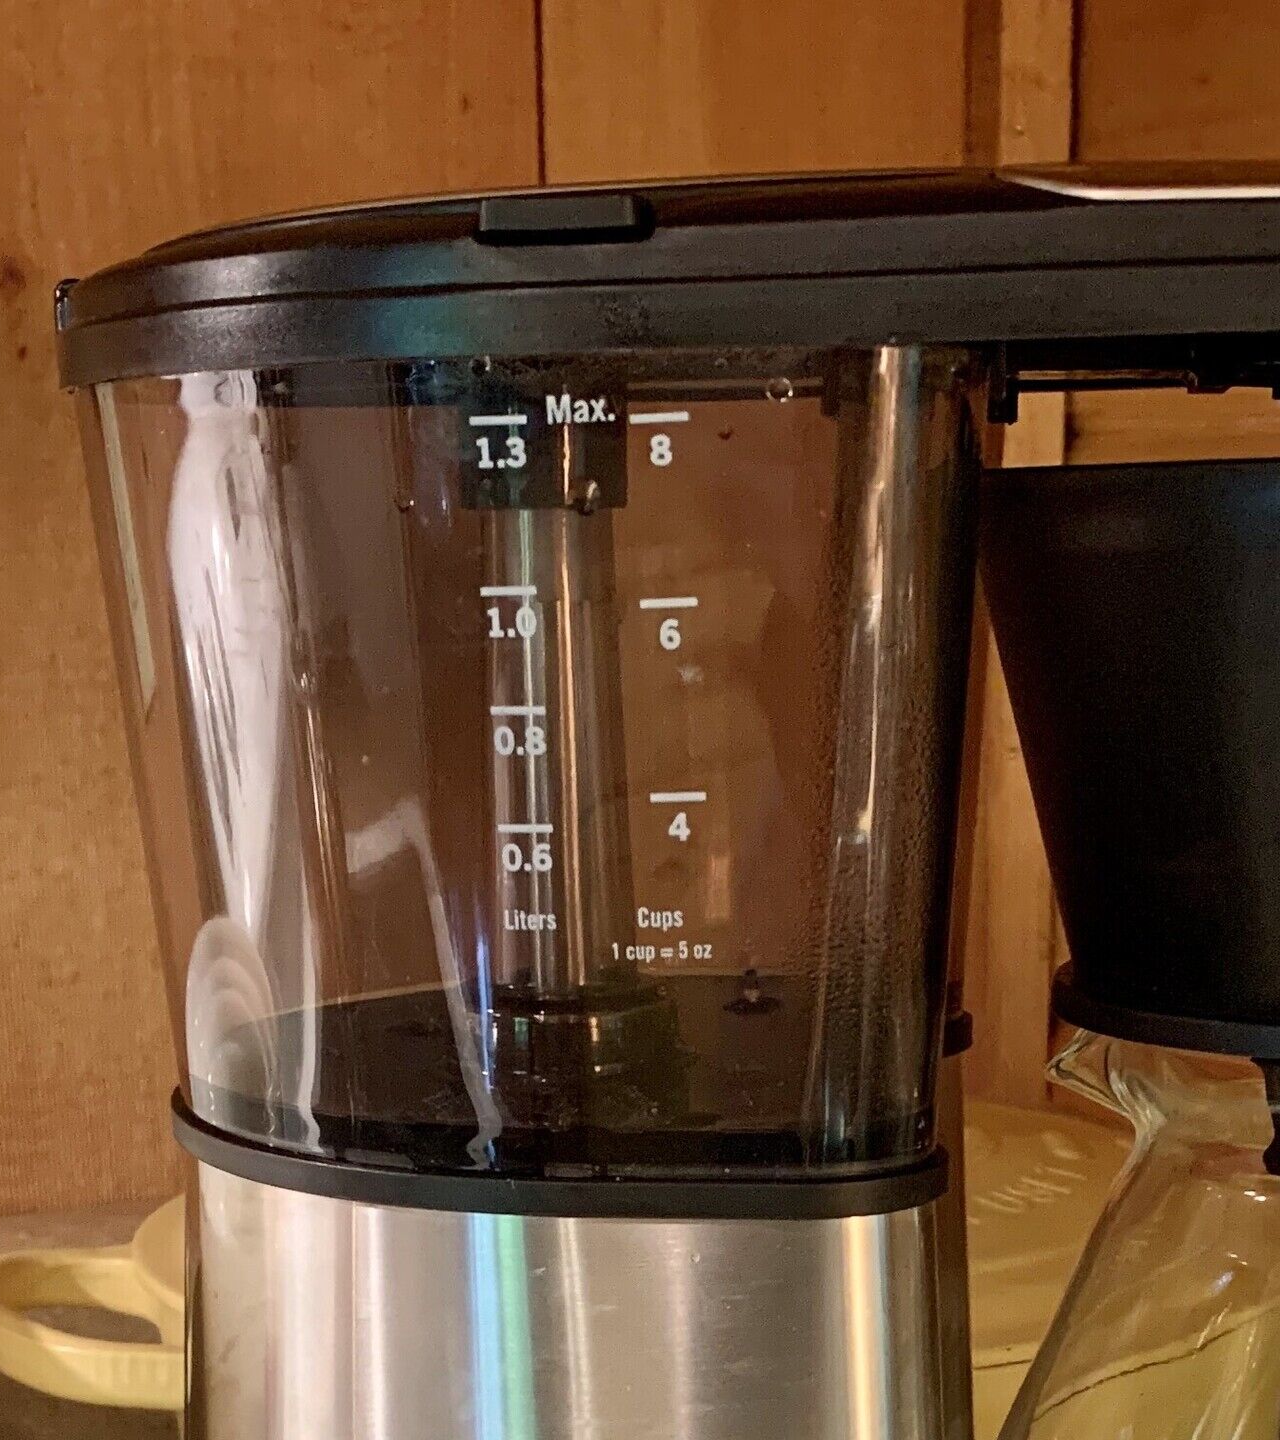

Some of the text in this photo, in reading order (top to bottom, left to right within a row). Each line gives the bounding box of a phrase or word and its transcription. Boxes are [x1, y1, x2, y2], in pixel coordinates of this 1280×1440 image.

[545, 394, 616, 426] Max.
[475, 436, 528, 469] 1.3
[649, 433, 673, 467] 8
[486, 606, 538, 638] 1.0
[658, 618, 682, 651] 6
[493, 725, 547, 756] 0.8
[668, 811, 691, 842] 4
[501, 843, 553, 873] 0.6
[504, 909, 557, 931] Liters
[637, 906, 684, 932] Cups
[611, 942, 620, 961] 1
[625, 946, 656, 962] cup
[677, 940, 688, 960] 5
[693, 942, 713, 960] oz
